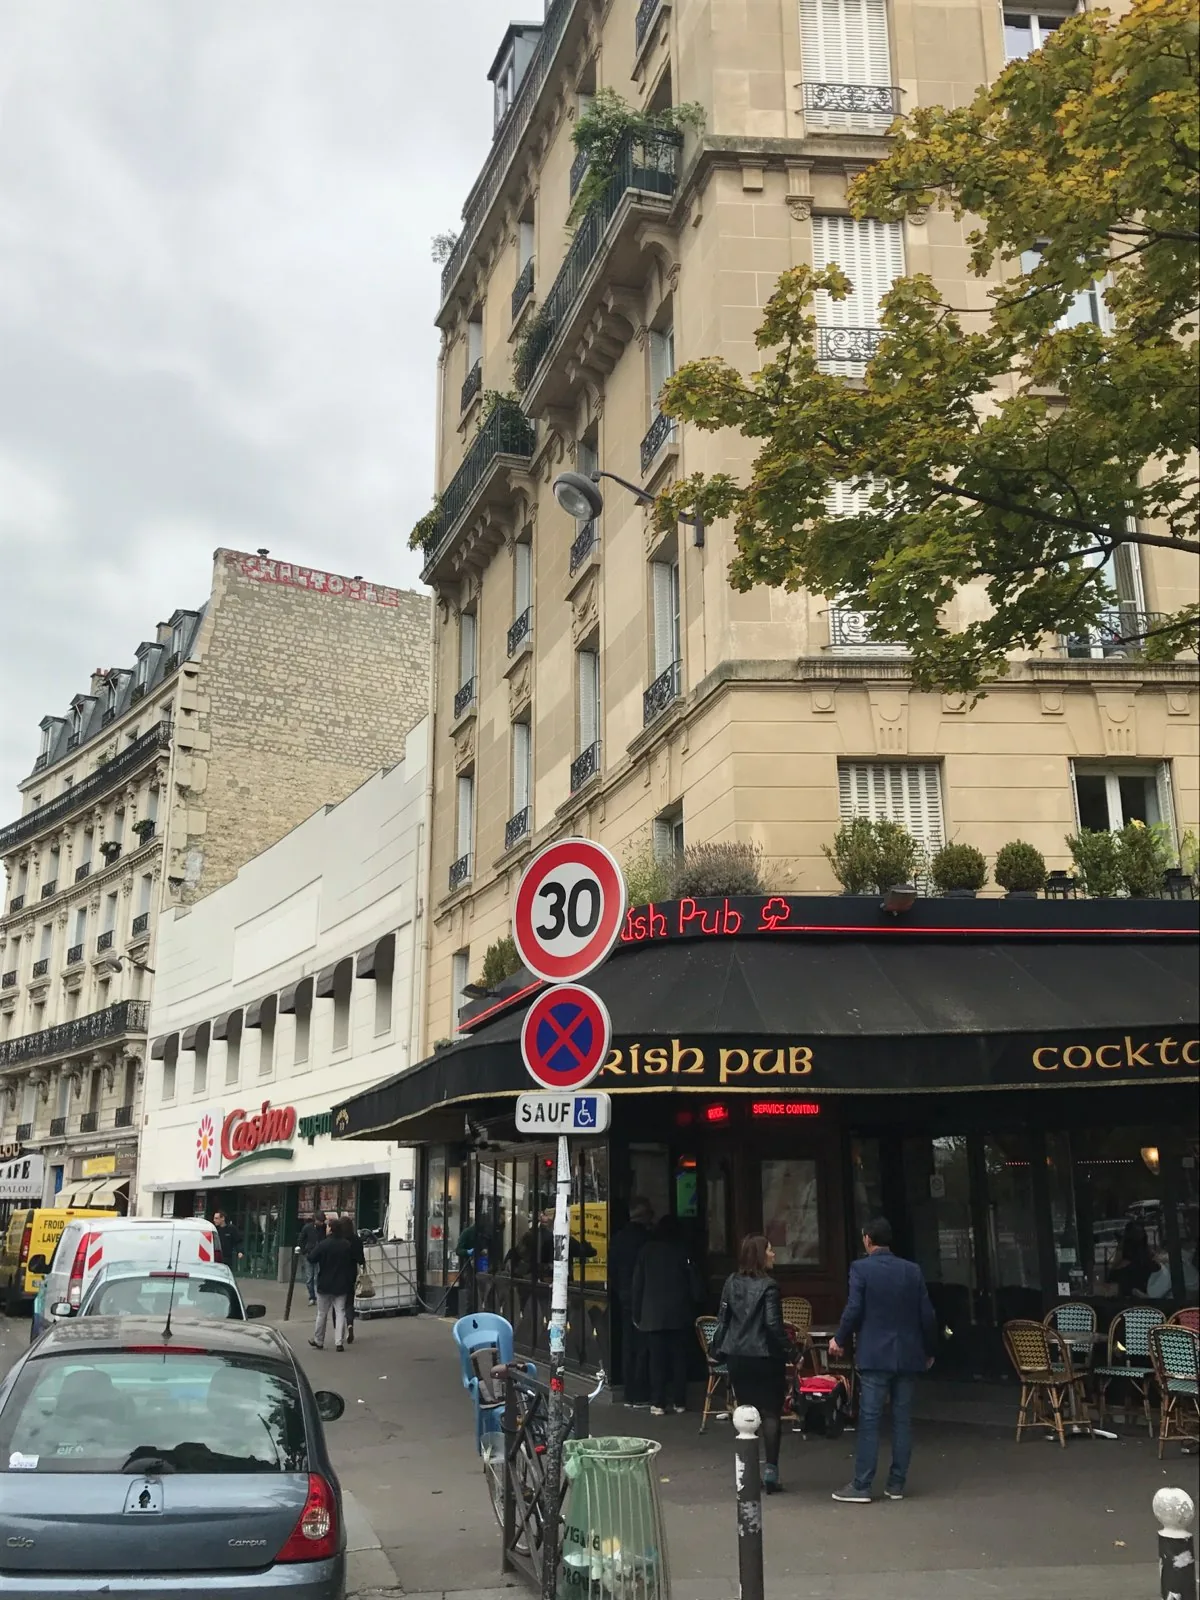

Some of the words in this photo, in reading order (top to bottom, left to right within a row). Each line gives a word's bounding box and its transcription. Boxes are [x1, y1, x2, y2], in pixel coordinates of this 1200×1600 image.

[536, 878, 601, 941] 30
[621, 903, 667, 941] ish
[679, 897, 742, 934] Pub
[521, 1102, 571, 1123] SAUF
[753, 1103, 785, 1114] SERVICE
[786, 1103, 820, 1115] CONTINU
[221, 1100, 297, 1160] Casino
[44, 1220, 65, 1229] FROID
[228, 1538, 268, 1547] Campus
